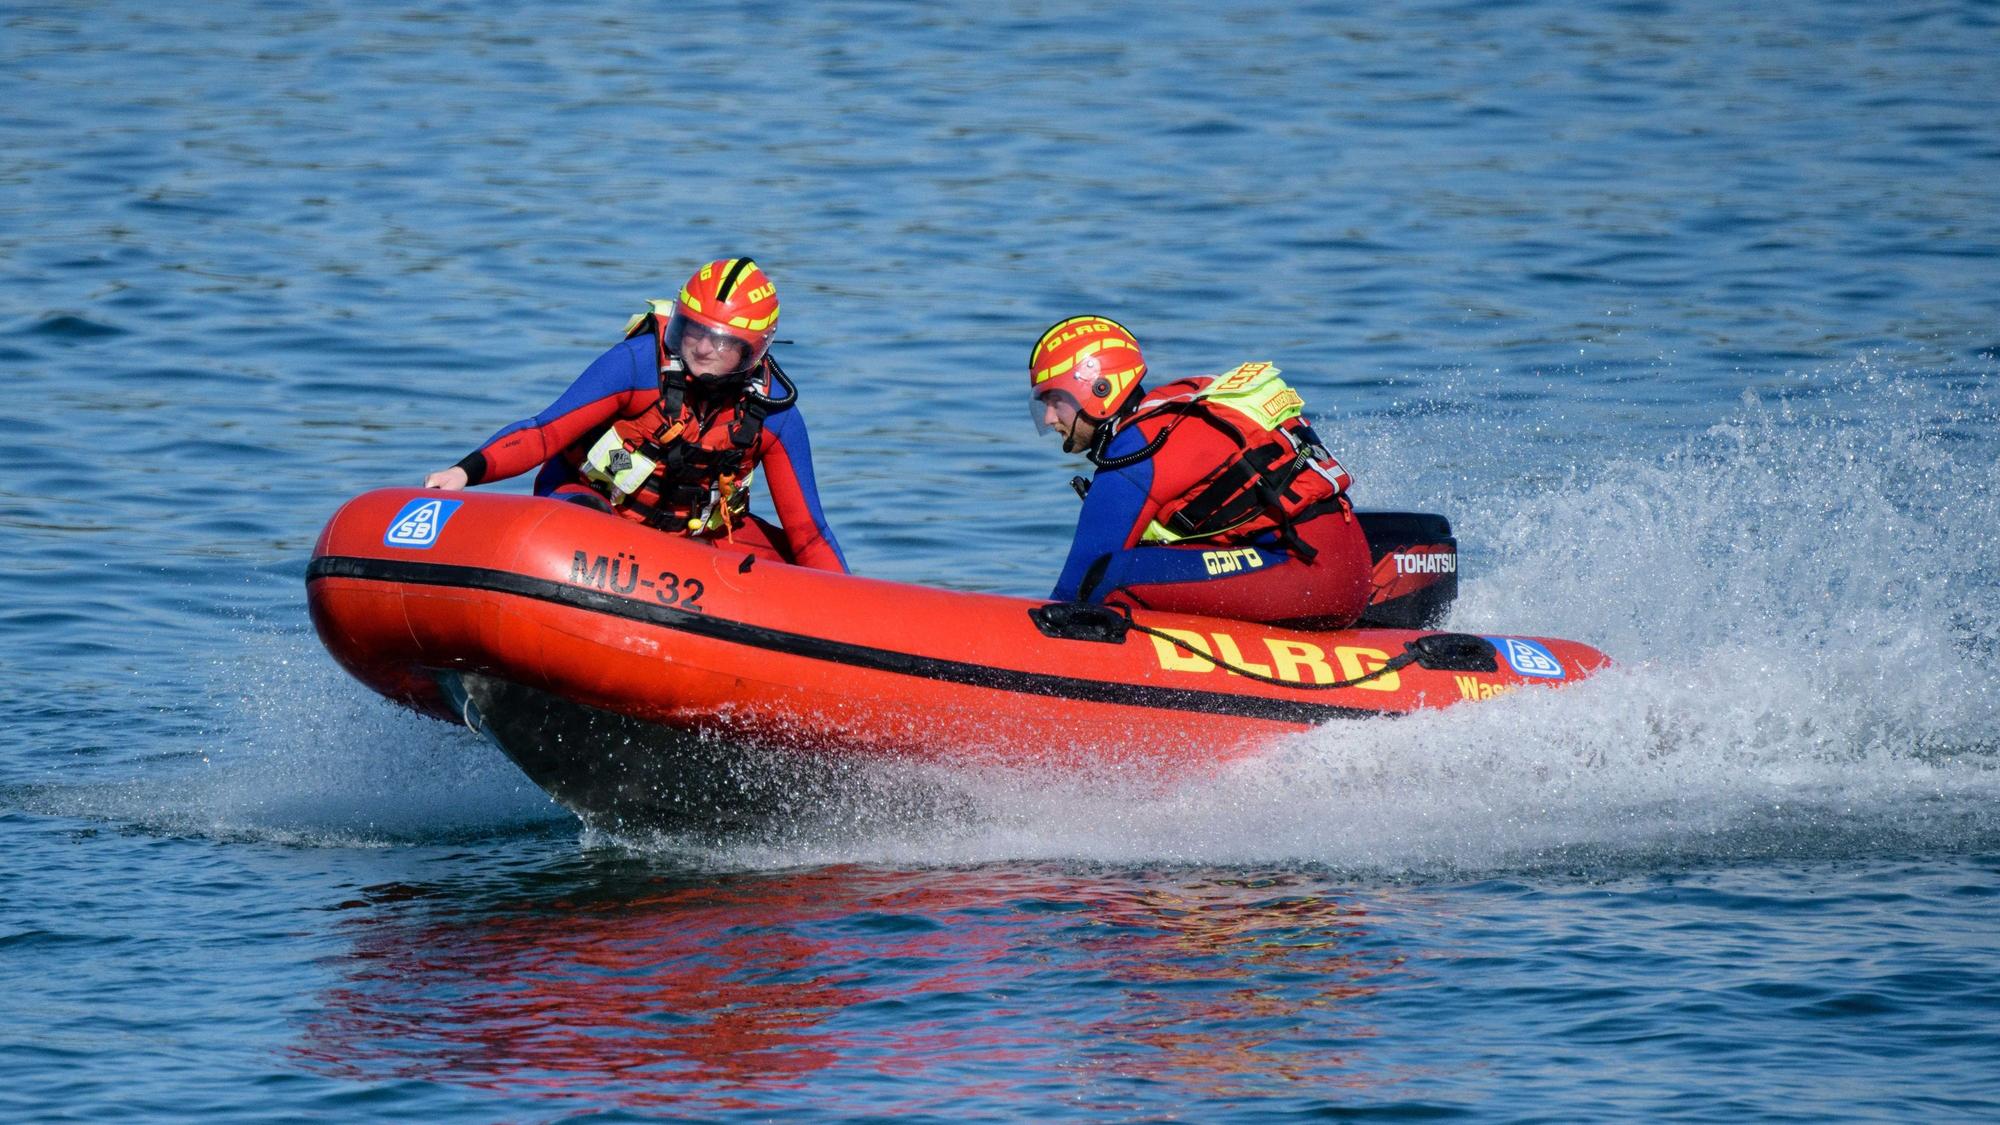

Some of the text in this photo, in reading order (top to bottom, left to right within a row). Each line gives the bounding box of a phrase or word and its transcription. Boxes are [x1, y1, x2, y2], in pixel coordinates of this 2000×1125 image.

[748, 281, 777, 304] DLR
[1046, 323, 1111, 353] DLRG
[398, 522, 433, 539] SB
[1393, 552, 1456, 574] TOHATSU
[569, 550, 705, 612] MÜ-32
[1150, 627, 1401, 693] DLRG
